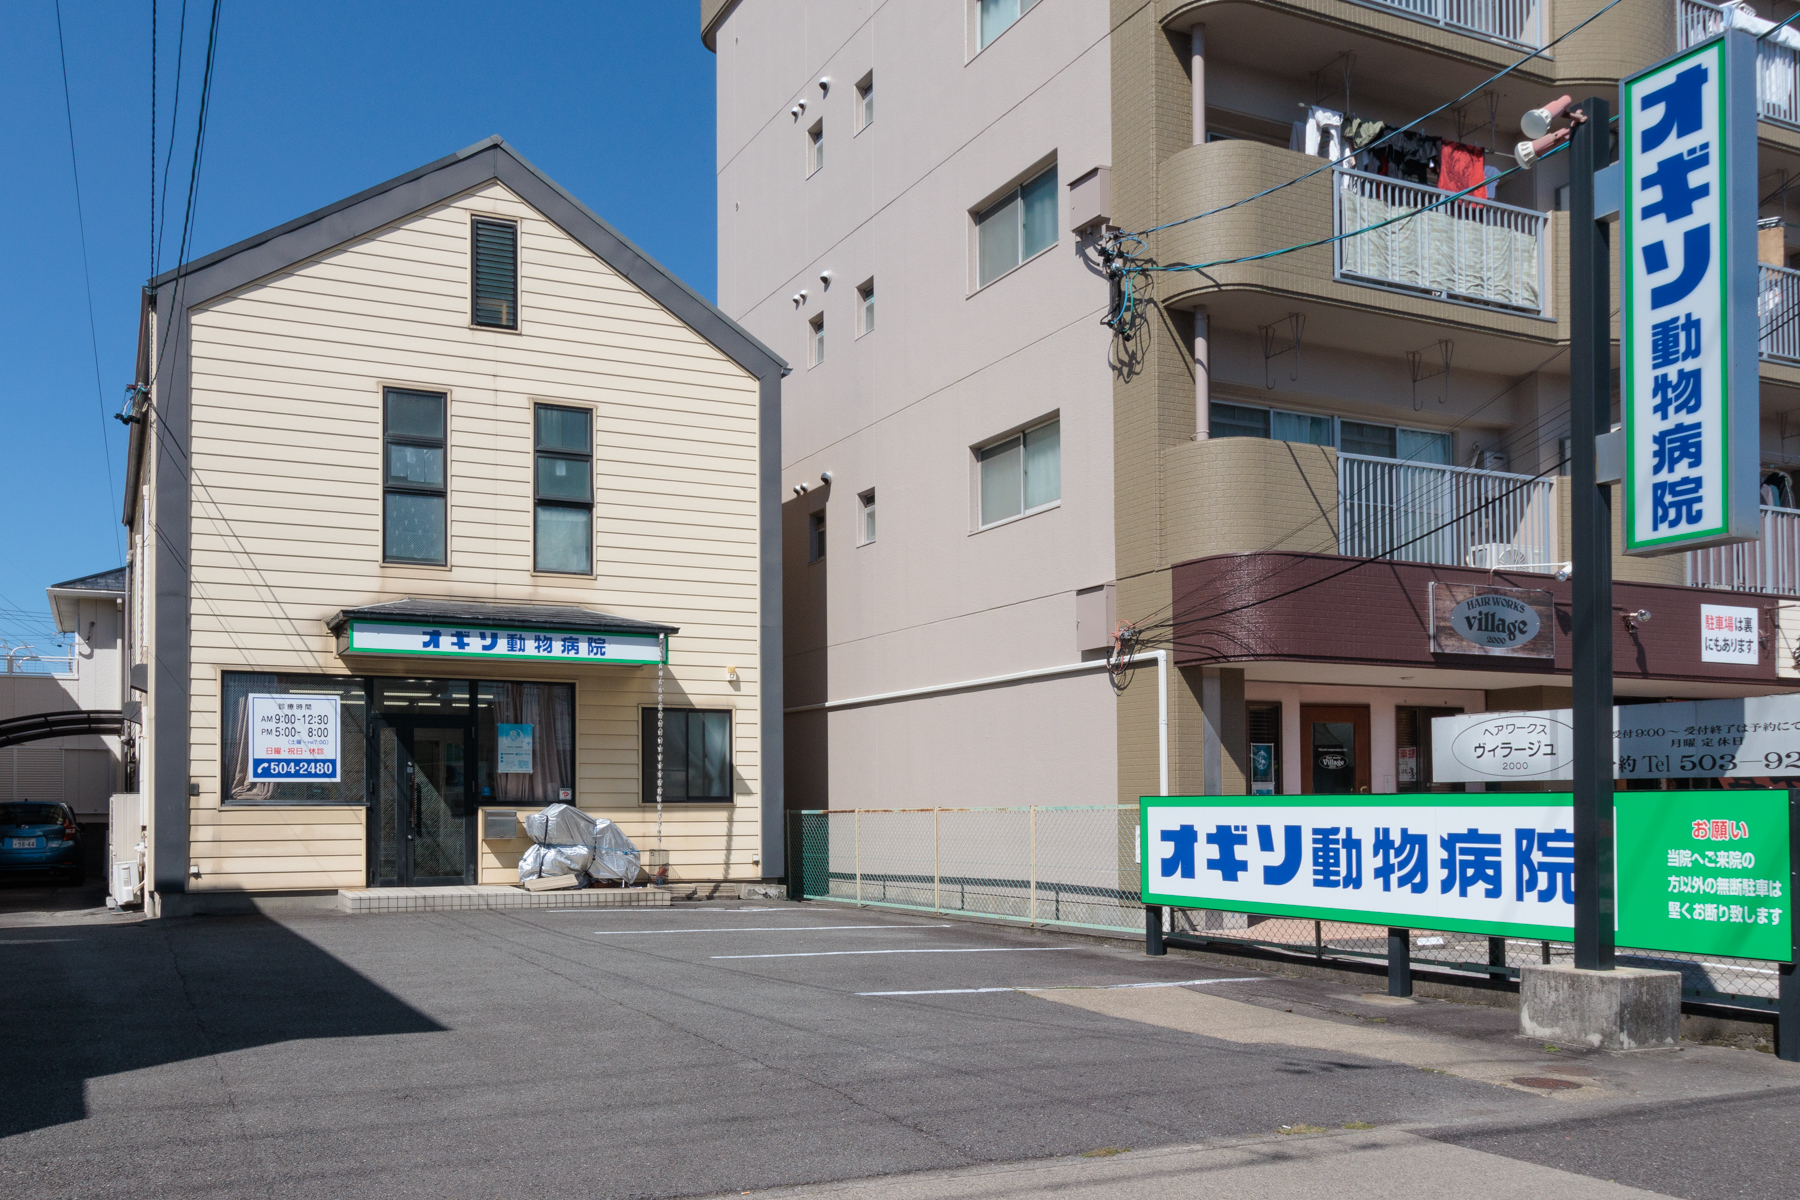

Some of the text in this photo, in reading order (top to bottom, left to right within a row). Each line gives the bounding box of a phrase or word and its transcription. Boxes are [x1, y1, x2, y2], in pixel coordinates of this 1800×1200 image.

[1640, 61, 1711, 532] オギソ動物病院
[1466, 596, 1526, 614] HAIR WORKS
[1705, 614, 1753, 633] 駐車場は裏
[422, 629, 606, 656] オギソ動物病院
[1486, 635, 1507, 645] 2000
[1705, 636, 1757, 655] にもあります。
[278, 702, 313, 711] 診療時間
[261, 713, 329, 725] AM 9:00-12:30
[261, 728, 273, 736] PM
[307, 727, 329, 738] 8:00
[1483, 723, 1548, 737] ヘアワークス
[270, 761, 333, 774] 504-2480
[1502, 762, 1529, 770] 2000
[1641, 754, 1671, 773] Tel
[1692, 819, 1749, 841] お願い
[1159, 823, 1574, 905] オギソ動物病院
[1667, 849, 1755, 869] 当院へご来院の
[1667, 875, 1783, 897] 方以外の無断駐車は
[1668, 901, 1783, 925] 堅くお断り致します
